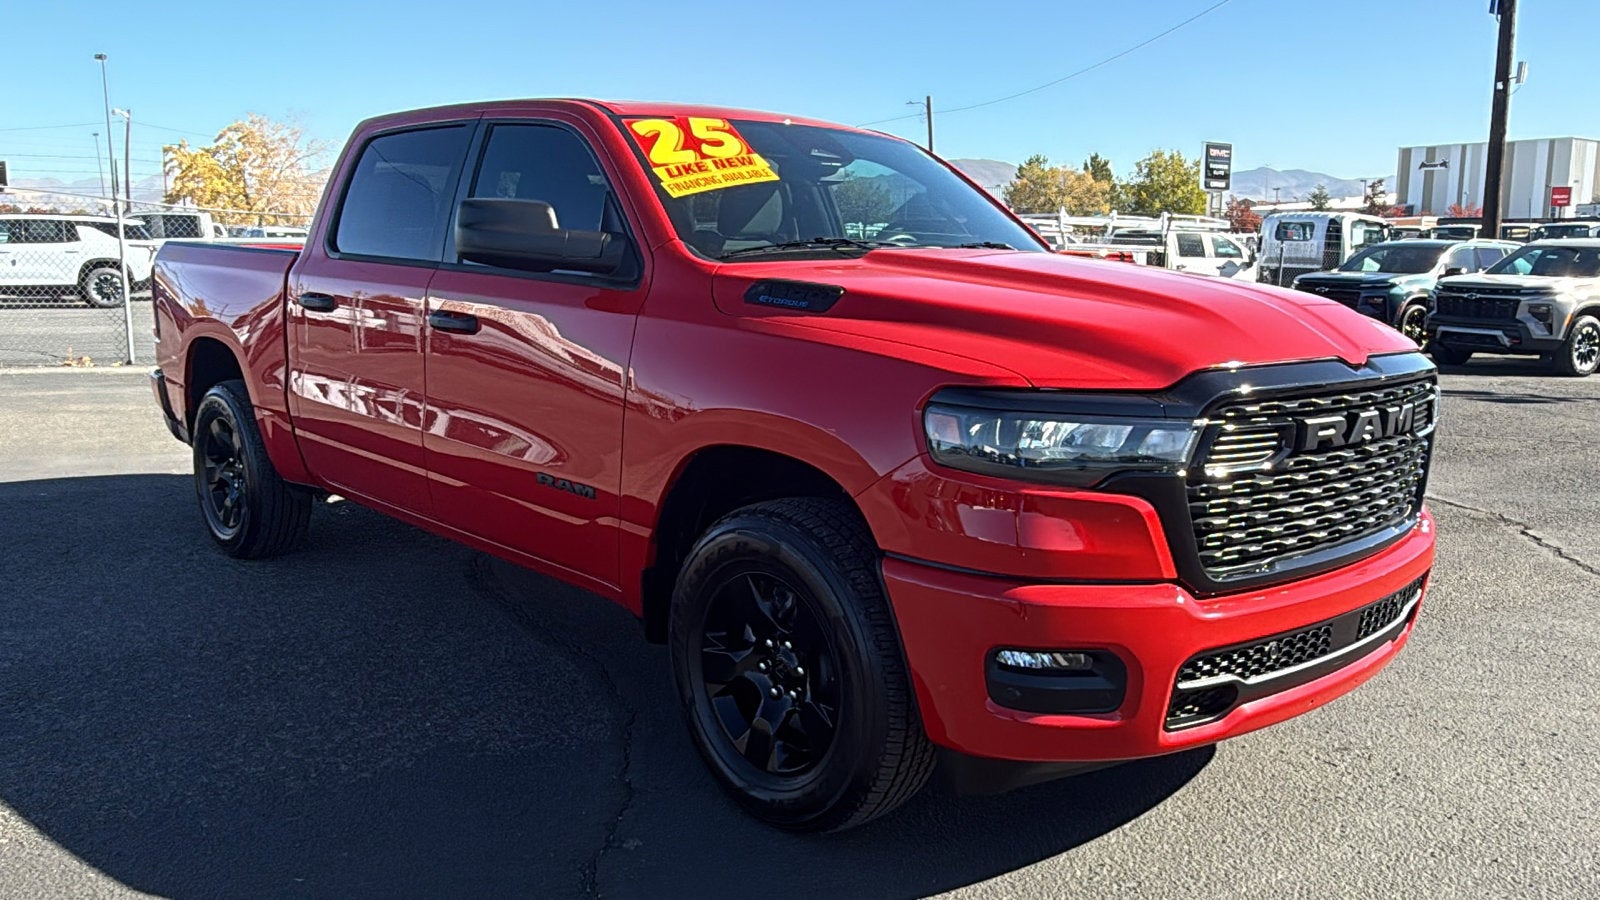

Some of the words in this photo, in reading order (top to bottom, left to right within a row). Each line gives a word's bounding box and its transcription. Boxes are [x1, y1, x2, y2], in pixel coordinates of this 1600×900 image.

[631, 117, 748, 165] 25
[1209, 148, 1230, 157] GMC
[665, 161, 710, 179] LIKE
[713, 155, 756, 171] NEW
[668, 175, 723, 194] FINANCING
[724, 168, 773, 187] AVAILABLE
[1303, 402, 1414, 450] RAM
[536, 472, 597, 500] RAM
